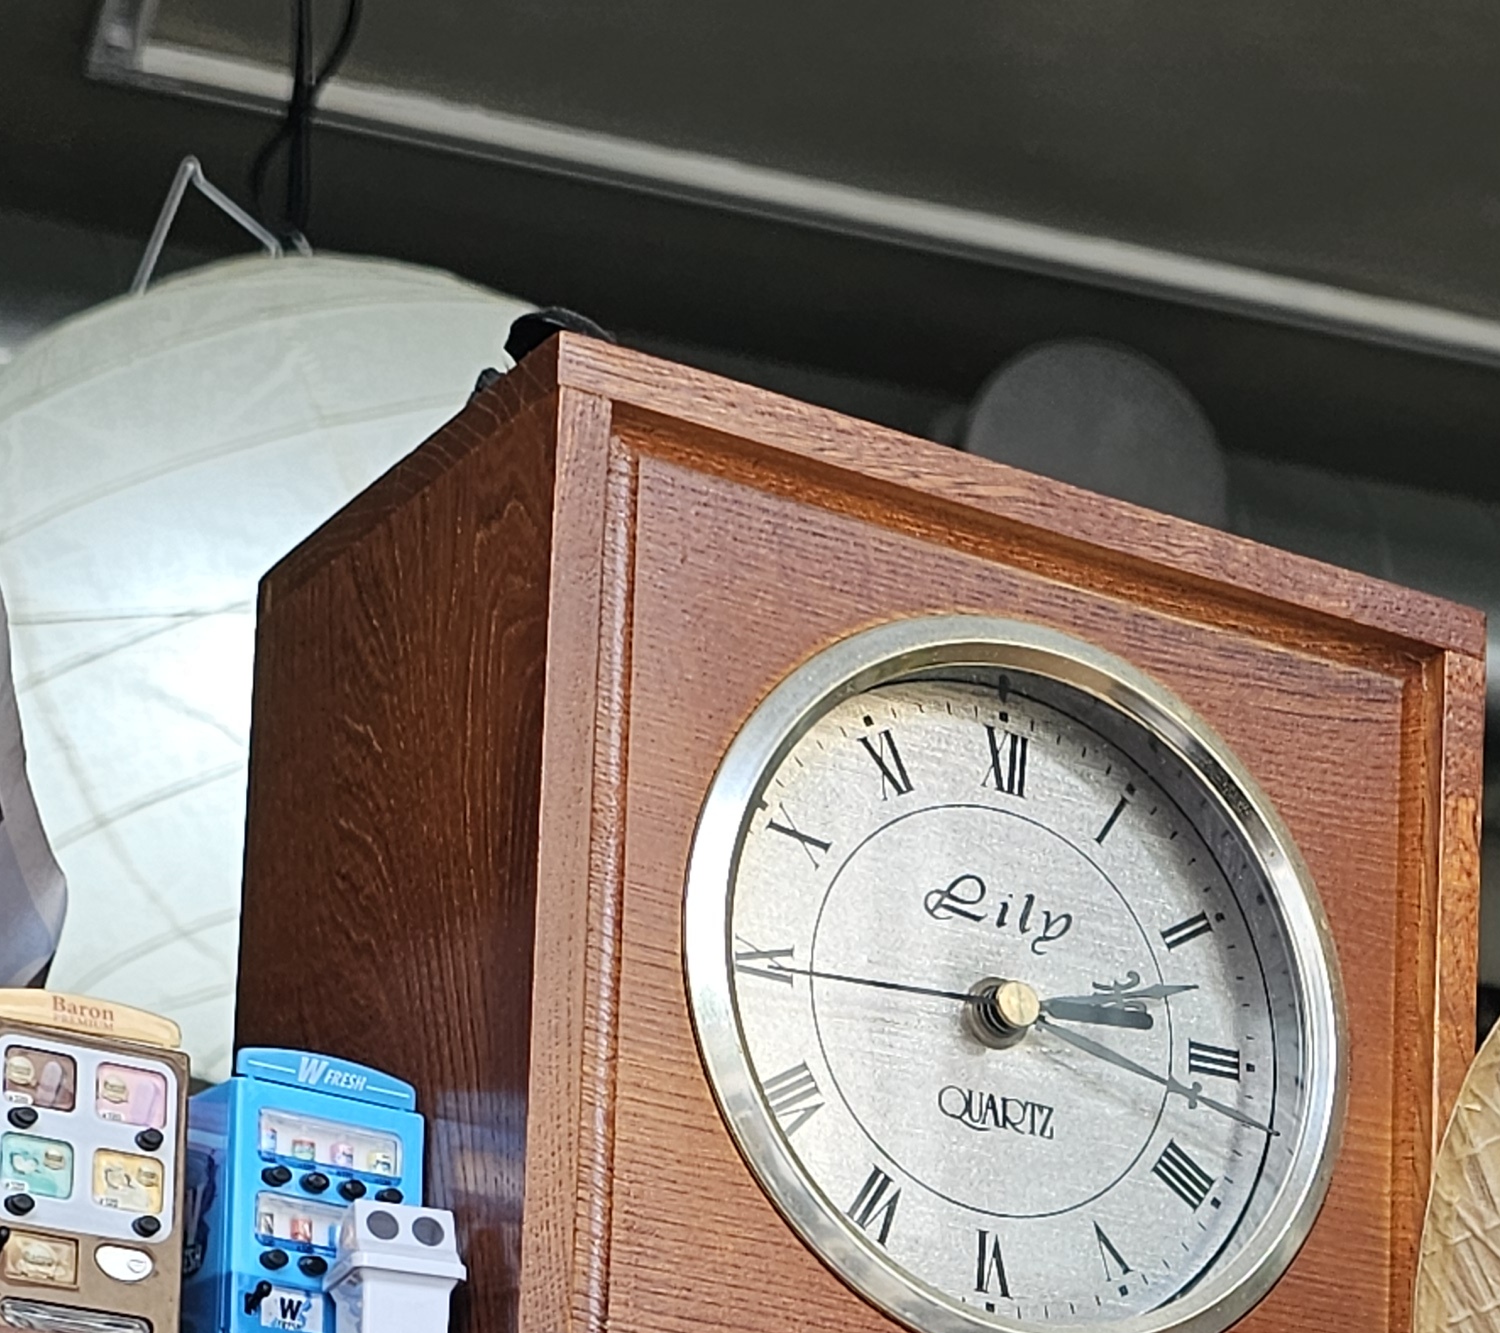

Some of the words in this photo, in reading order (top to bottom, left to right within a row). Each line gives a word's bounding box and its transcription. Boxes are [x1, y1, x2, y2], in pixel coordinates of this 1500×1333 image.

[924, 874, 1073, 955] Lily
[52, 995, 114, 1022] Baron
[53, 1014, 114, 1031] PREMIUM
[938, 1085, 1054, 1140] QUARTZ
